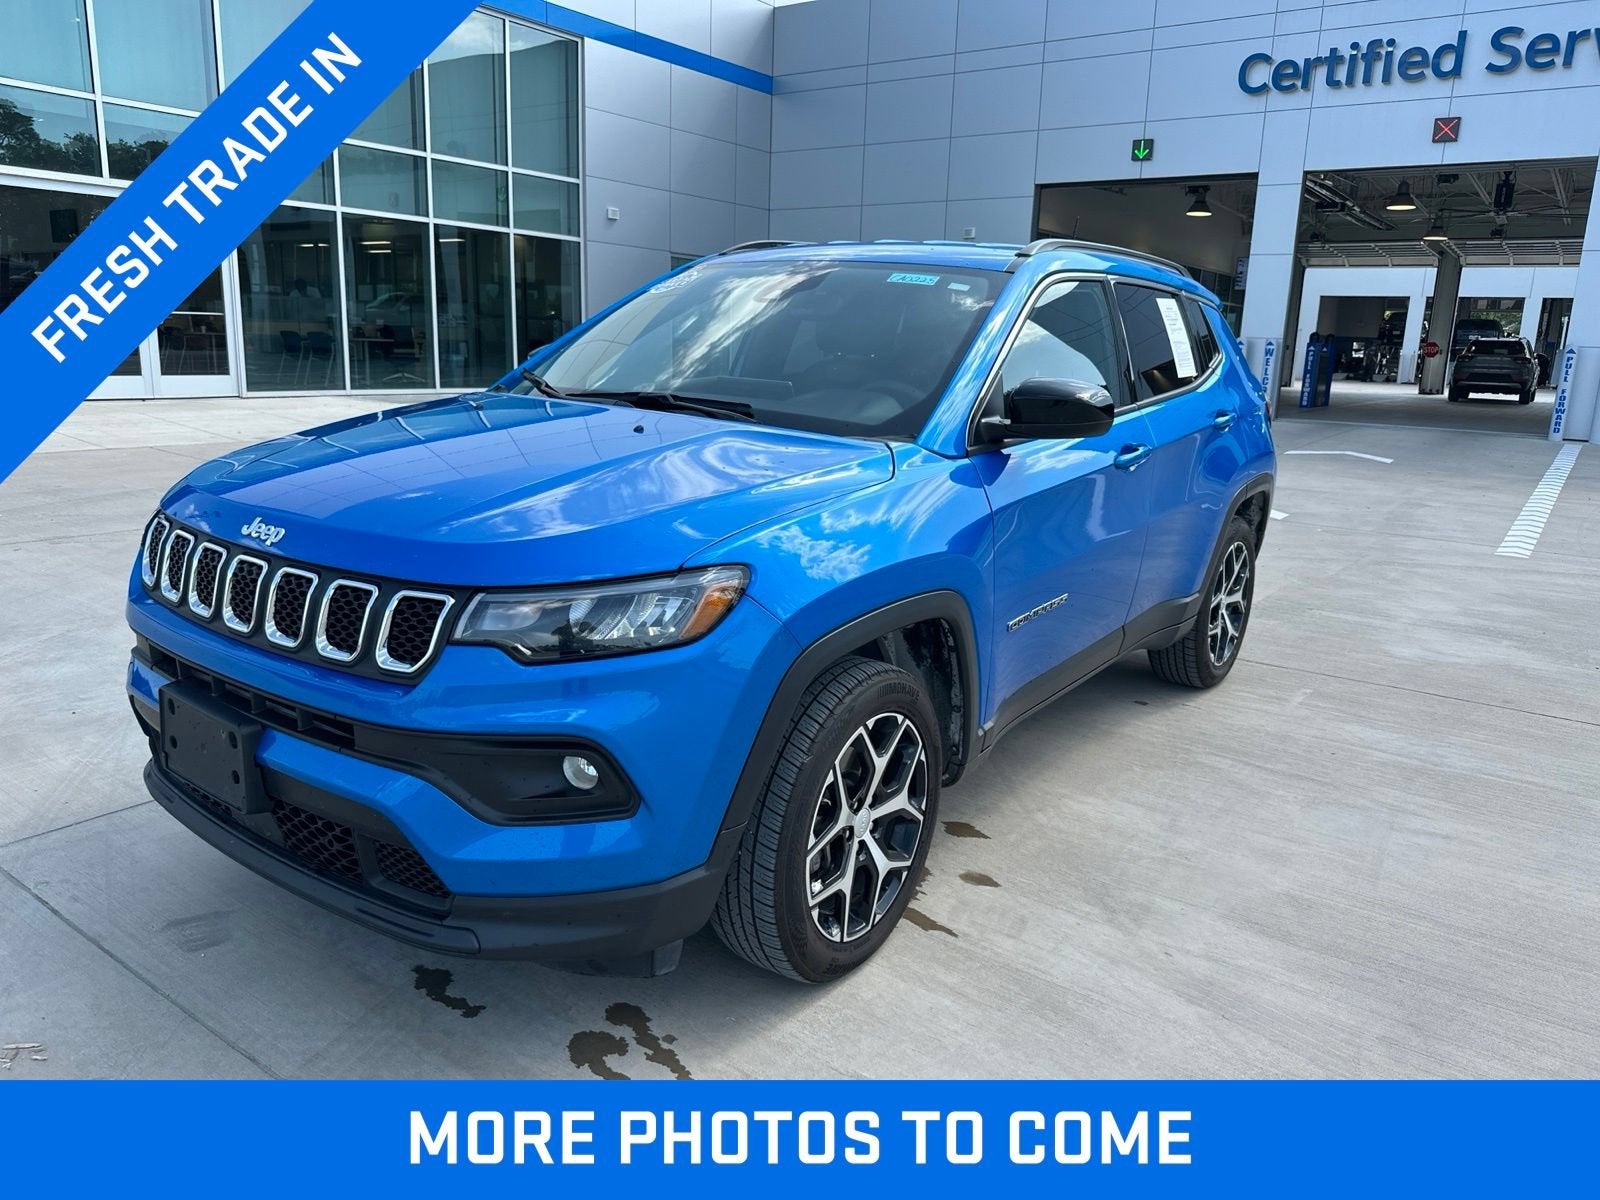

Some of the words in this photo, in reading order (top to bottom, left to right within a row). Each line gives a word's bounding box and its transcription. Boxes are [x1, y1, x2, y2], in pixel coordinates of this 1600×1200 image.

[1238, 30, 1468, 96] Certified
[1564, 356, 1574, 383] PULL
[1553, 389, 1566, 434] FORWARD
[241, 516, 286, 547] Jeep
